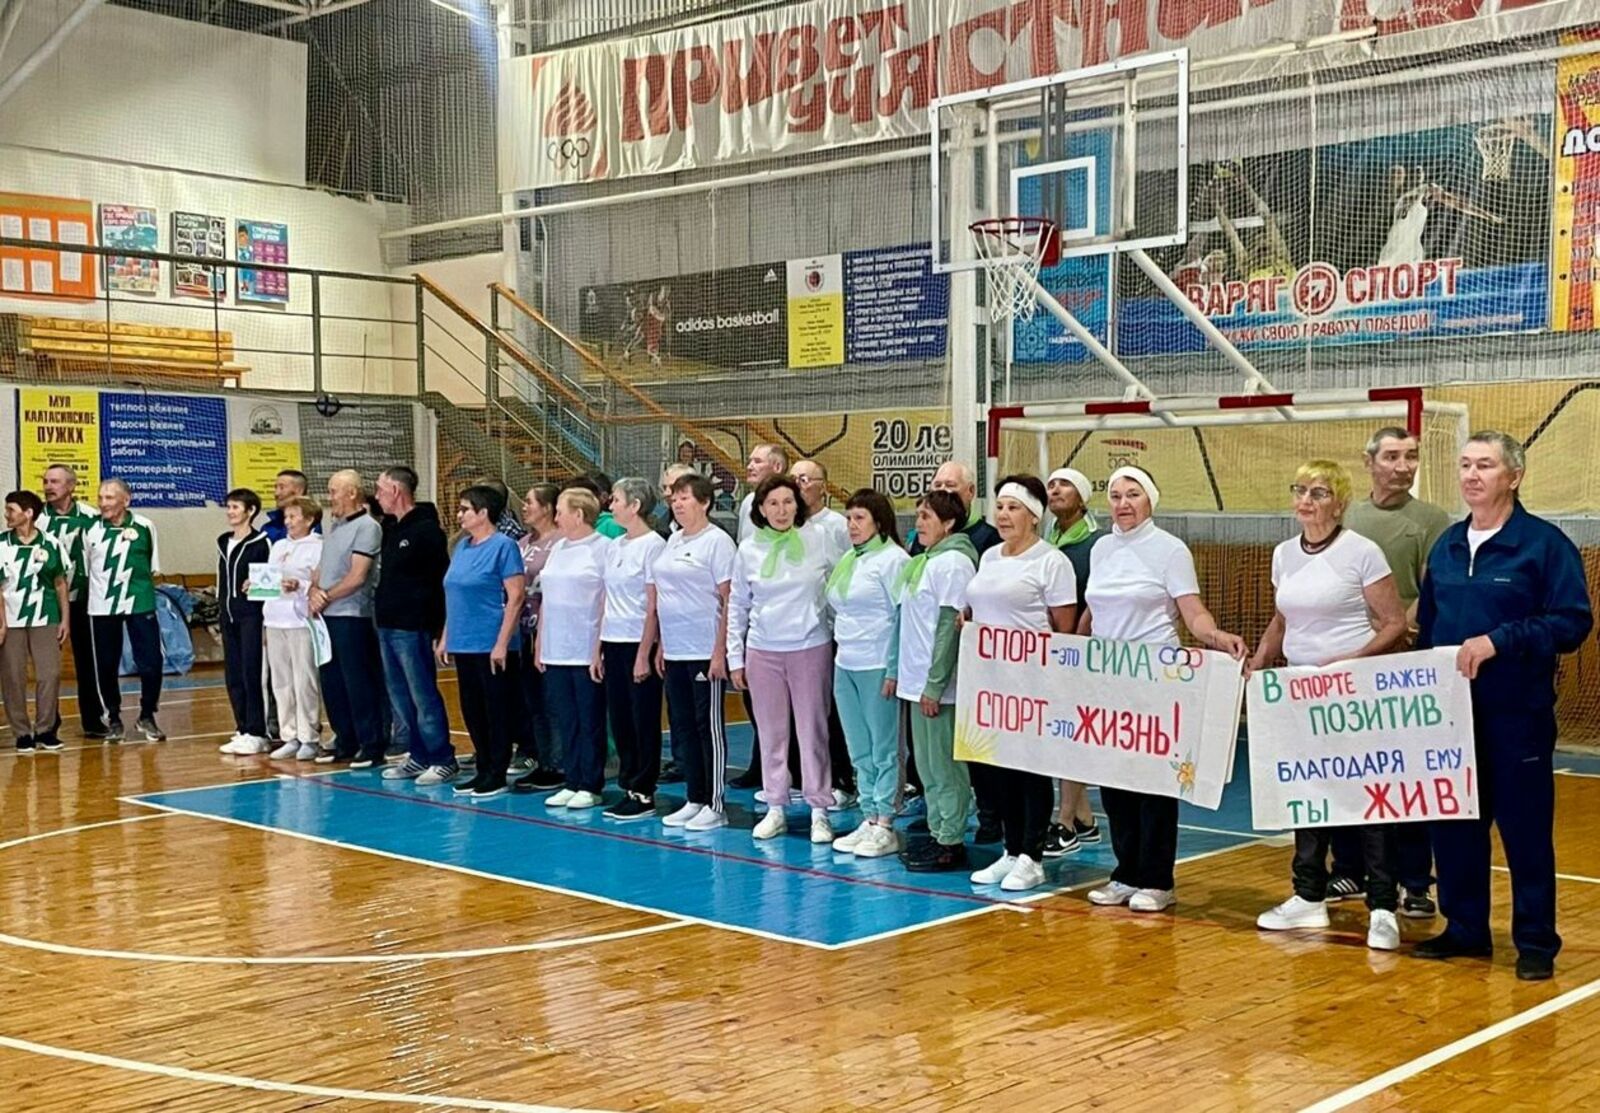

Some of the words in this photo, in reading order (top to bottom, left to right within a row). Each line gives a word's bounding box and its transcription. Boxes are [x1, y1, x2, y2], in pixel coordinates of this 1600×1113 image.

[1343, 258, 1462, 304] СПОРТ
[675, 316, 715, 333] adidas
[716, 308, 780, 329] basketball
[1261, 324, 1299, 341] СВОЮ
[37, 426, 84, 444] ПУЖКХ
[872, 419, 908, 451] 20
[913, 425, 952, 450] ле
[872, 453, 952, 467] ОЛИМПИЙСК
[872, 472, 933, 496] ПОБЕ
[1091, 480, 1109, 492] 19
[1262, 670, 1283, 703] В
[1289, 672, 1357, 701] СПОРТЕ
[1375, 667, 1437, 691] ВАЖЕН
[1277, 749, 1406, 783] БЛАГОДАРЯ
[1424, 747, 1463, 771] ЕМУ
[1286, 798, 1329, 824] ТЫ
[1363, 766, 1473, 820] ЖИВ!
